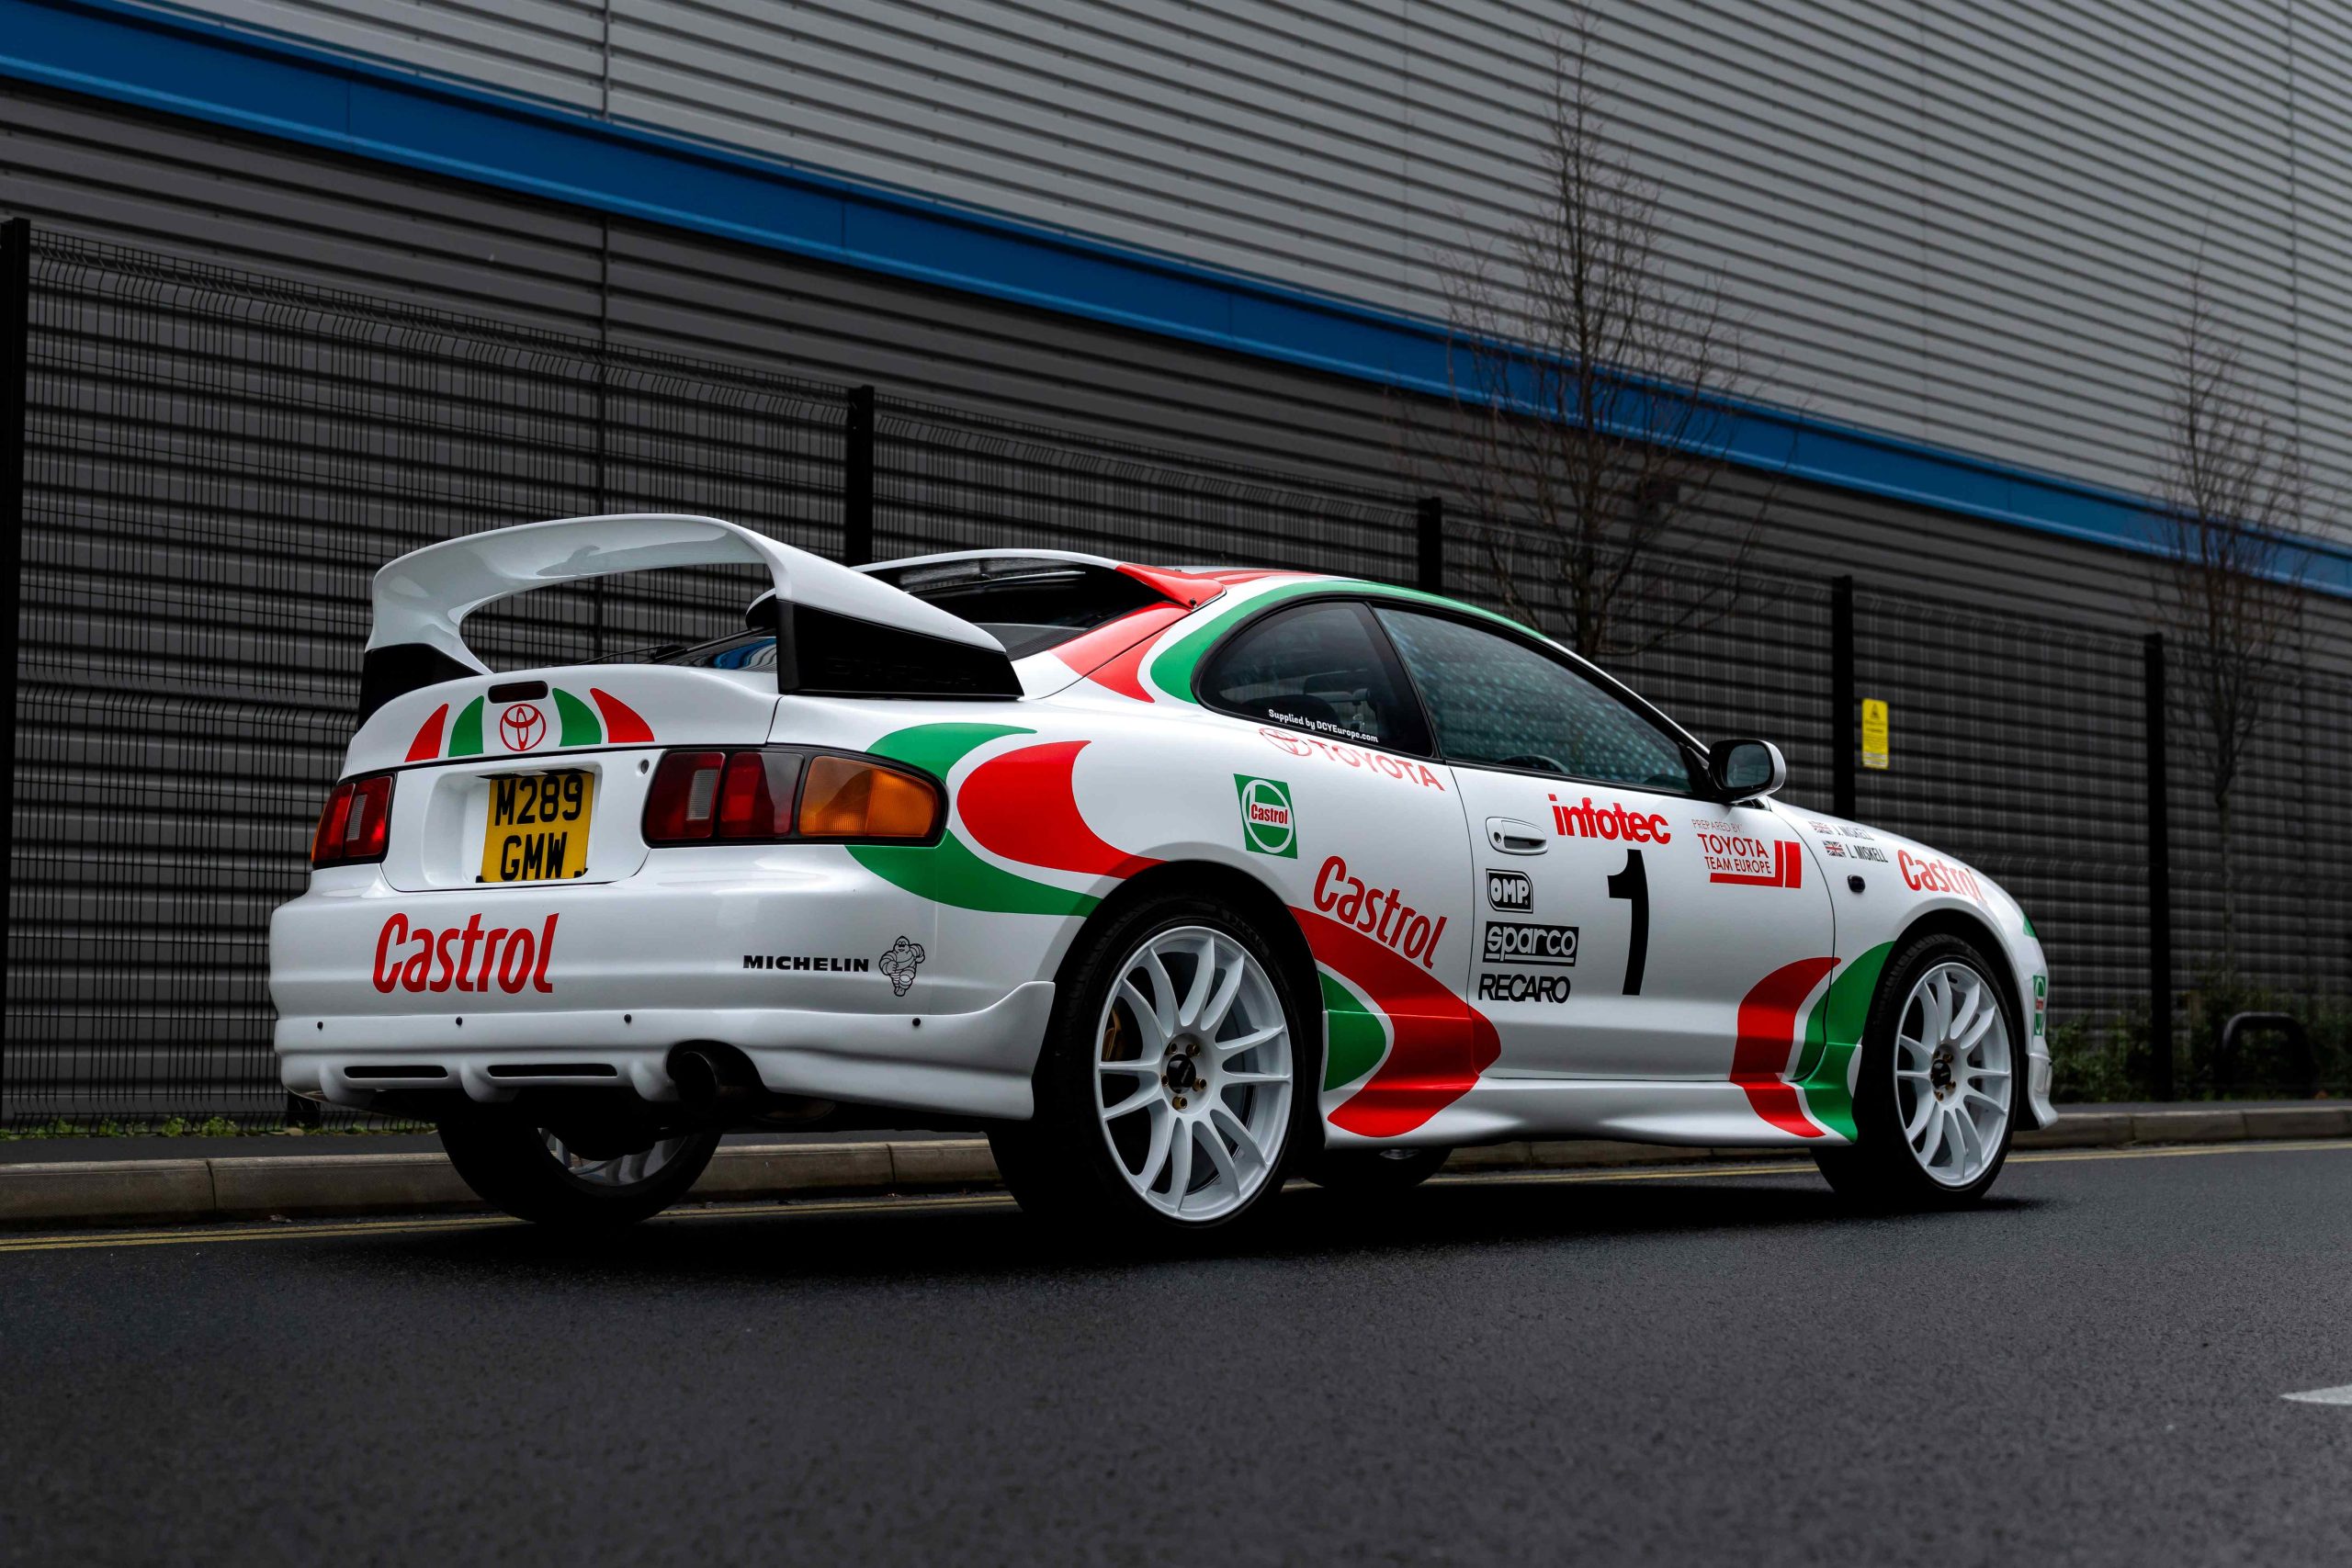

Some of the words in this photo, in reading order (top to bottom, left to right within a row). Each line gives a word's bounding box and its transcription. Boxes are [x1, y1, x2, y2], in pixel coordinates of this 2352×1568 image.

[1268, 708, 1304, 726] Supplied
[1305, 717, 1316, 730] by
[1317, 720, 1379, 743] DCYEurope.com
[1308, 739, 1446, 792] TOYOTA
[494, 773, 583, 826] M289
[1250, 804, 1288, 825] Castrol
[1548, 794, 1671, 844] infotec
[1690, 818, 1732, 833] PREPARED
[500, 831, 568, 882] GMW
[1697, 832, 1770, 859] TOYOTA
[1853, 844, 1889, 863] MISKELL
[1704, 856, 1733, 871] TEAM
[1734, 858, 1772, 874] EUROPE
[1897, 849, 1988, 906] Castrol
[1489, 877, 1530, 904] OMP
[1313, 855, 1448, 970] Castrol
[1607, 848, 1649, 996] 1
[372, 912, 560, 994] Castrol
[1487, 925, 1577, 962] sparco
[743, 954, 870, 973] MICHELIN
[1477, 973, 1571, 1004] RECARO
